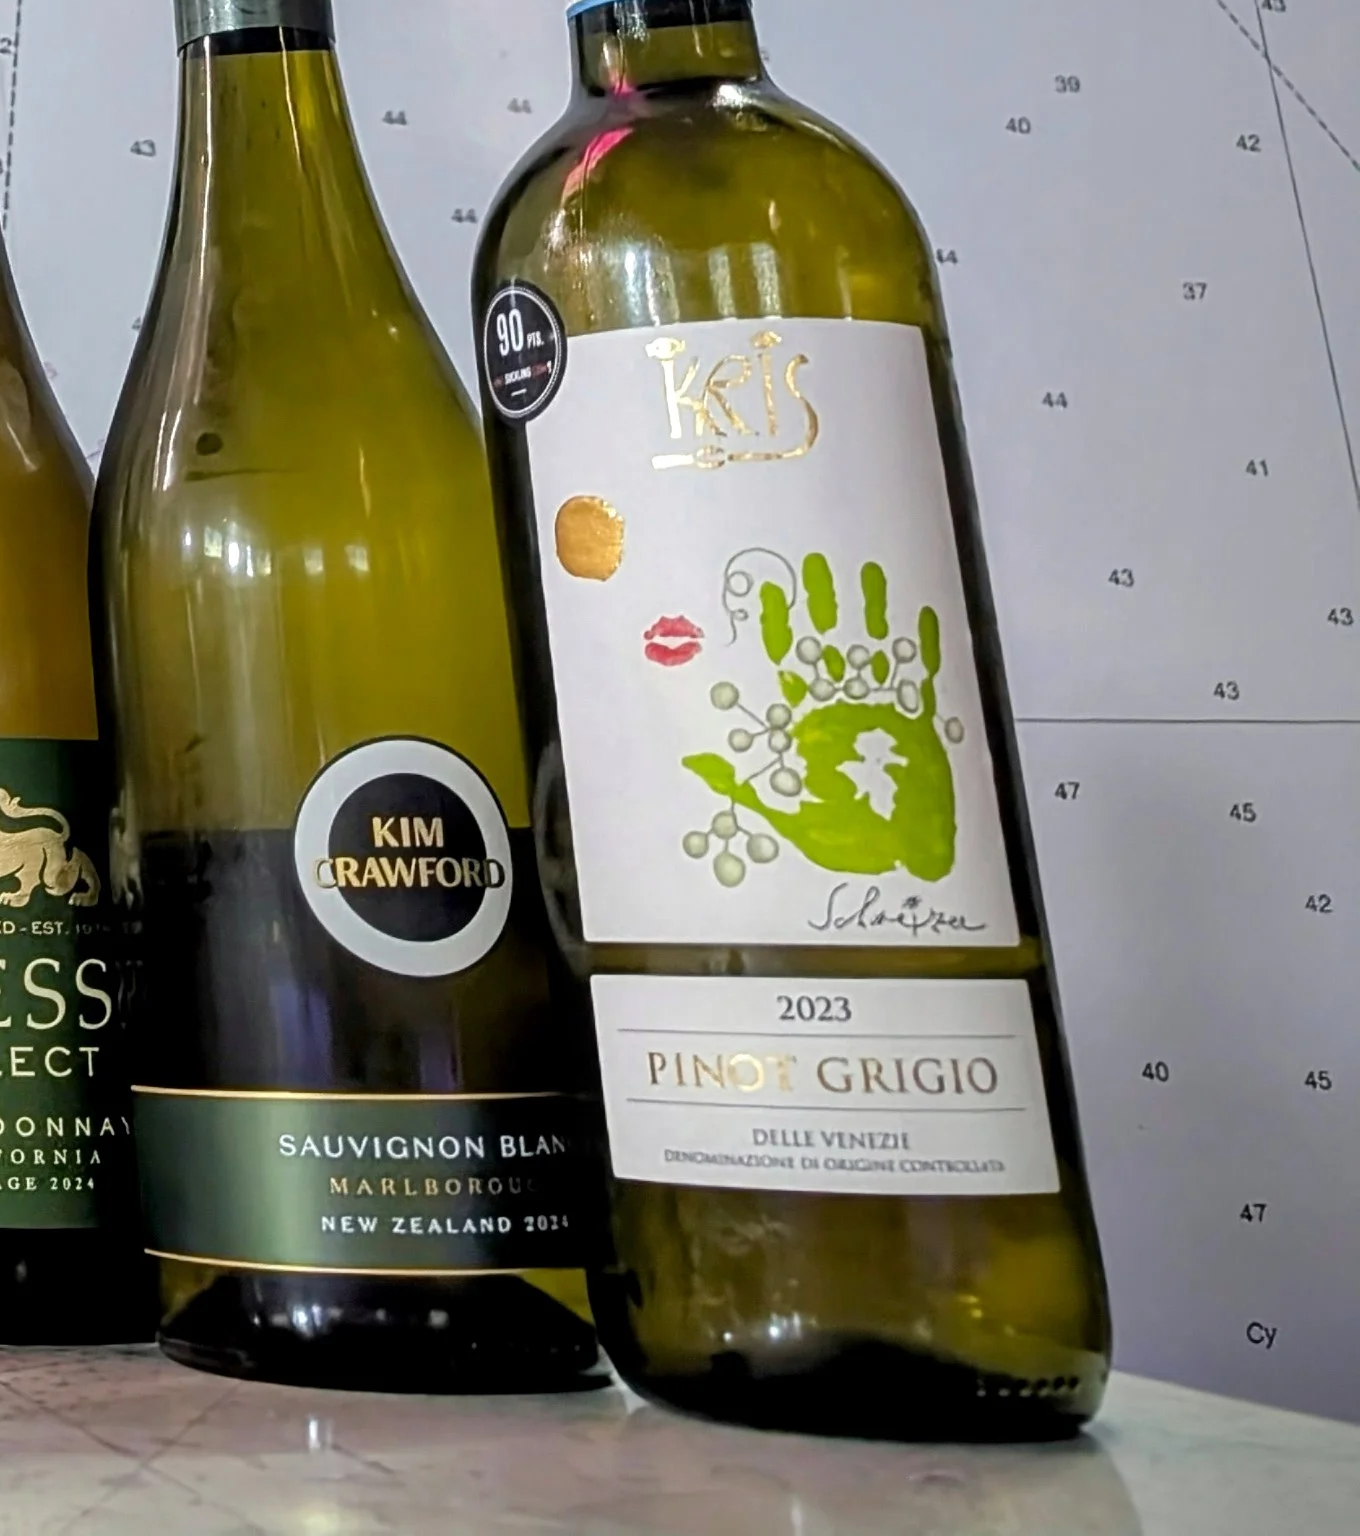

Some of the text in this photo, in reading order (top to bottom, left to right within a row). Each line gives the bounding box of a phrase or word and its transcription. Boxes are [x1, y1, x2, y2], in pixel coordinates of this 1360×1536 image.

[496, 309, 524, 357] 90
[1042, 390, 1070, 410] 44
[1055, 781, 1081, 801] 47
[372, 816, 444, 849] KIM
[313, 856, 506, 890] CRAWFORD
[32, 921, 69, 935] EST.
[777, 996, 852, 1023] 2023
[647, 1050, 998, 1094] PINOT GRIGIO
[1304, 1068, 1333, 1092] 45
[279, 1134, 572, 1160] SAUVIGNON BLAN
[752, 1128, 911, 1151] DELLE VENEZIE
[50, 1177, 95, 1190] 2024
[321, 1215, 378, 1233] NEW
[391, 1216, 513, 1235] ZEALAND
[1240, 1202, 1267, 1224] 47
[1246, 1320, 1278, 1350] Cy
